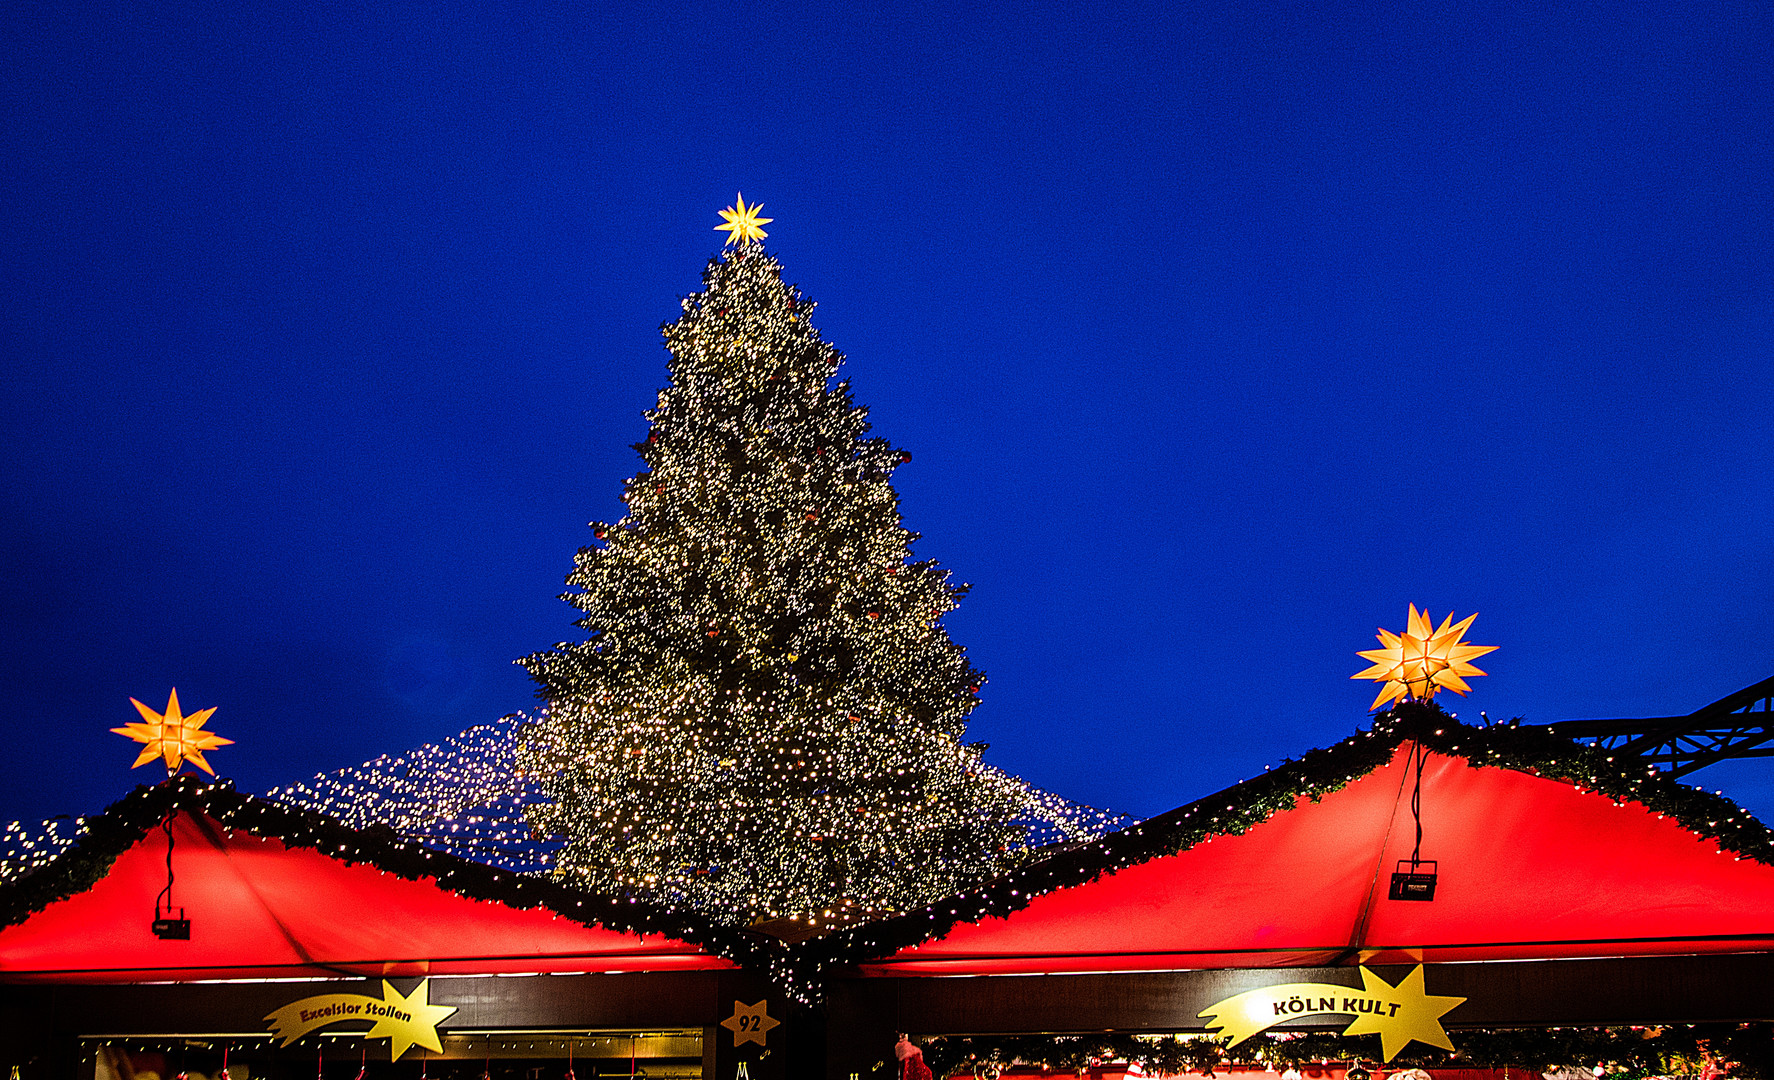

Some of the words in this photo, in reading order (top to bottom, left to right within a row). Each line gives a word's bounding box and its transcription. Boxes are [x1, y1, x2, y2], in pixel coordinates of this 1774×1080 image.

[300, 1002, 361, 1022] Excelsior
[365, 1002, 411, 1022] Stollen
[1273, 996, 1335, 1015] KÖLN
[1343, 998, 1401, 1017] KULT
[739, 1015, 761, 1032] 92
